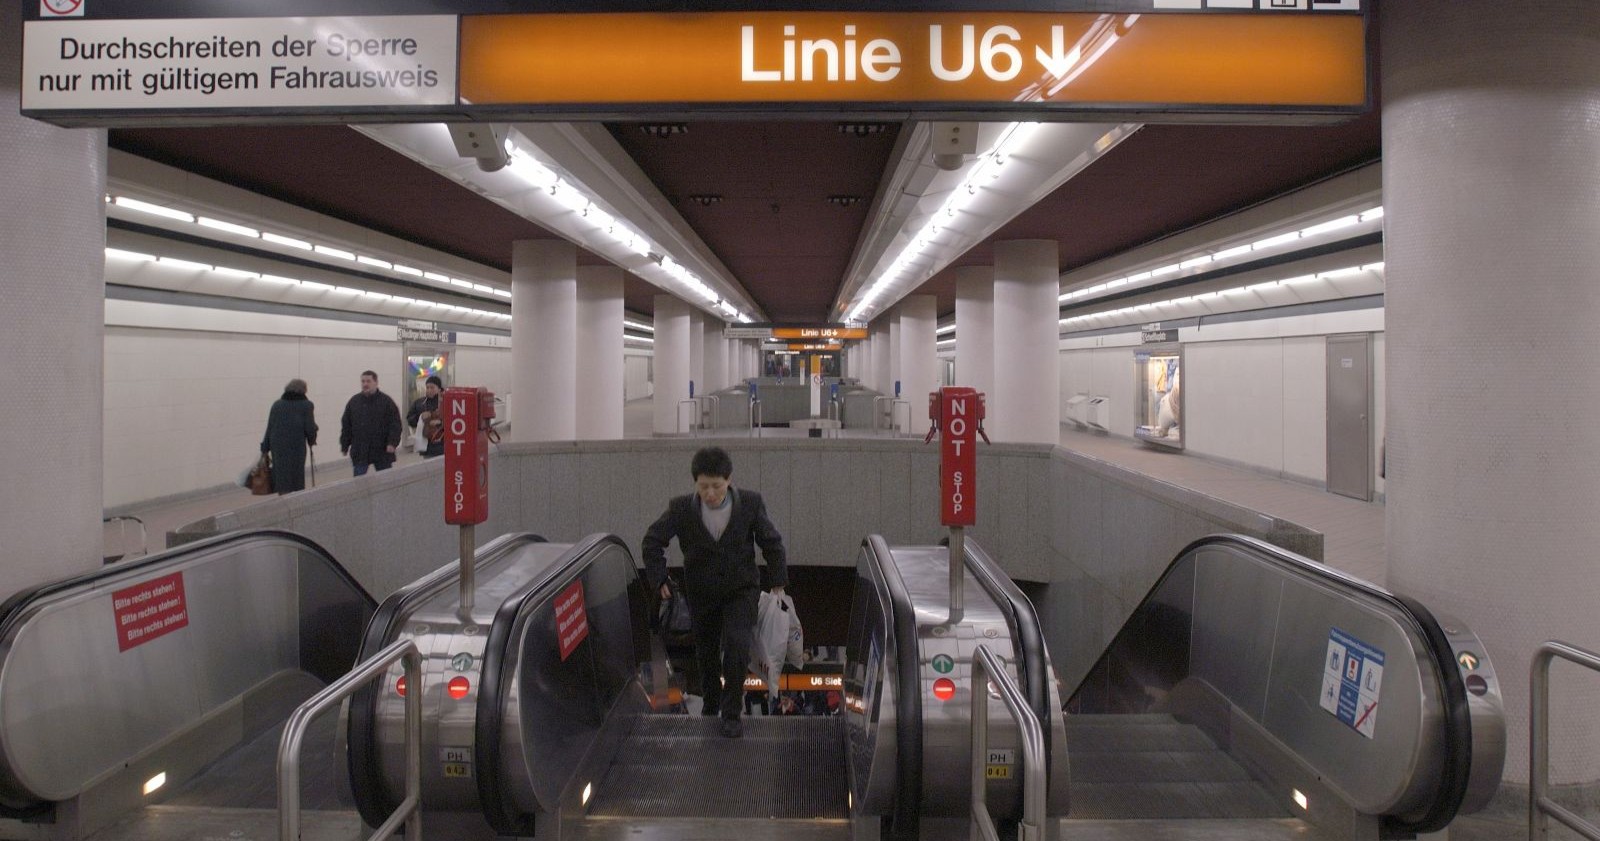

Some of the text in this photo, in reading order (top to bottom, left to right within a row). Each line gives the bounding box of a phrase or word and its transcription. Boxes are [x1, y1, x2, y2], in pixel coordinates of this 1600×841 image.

[60, 33, 418, 61] Durchschreiten der Sperre
[740, 25, 1023, 82] Linie U6
[39, 66, 438, 95] nur mit gültigem Fahrausweis
[451, 399, 466, 514] NOT STOP
[950, 399, 966, 514] NOT STOP
[115, 598, 131, 610] Bitte
[132, 591, 151, 604] rechts
[121, 613, 137, 625] Bitte
[138, 605, 157, 618] rechts
[128, 628, 143, 641] Bitte
[144, 620, 163, 634] rechts
[447, 751, 463, 760] PH
[990, 753, 1006, 762] PH
